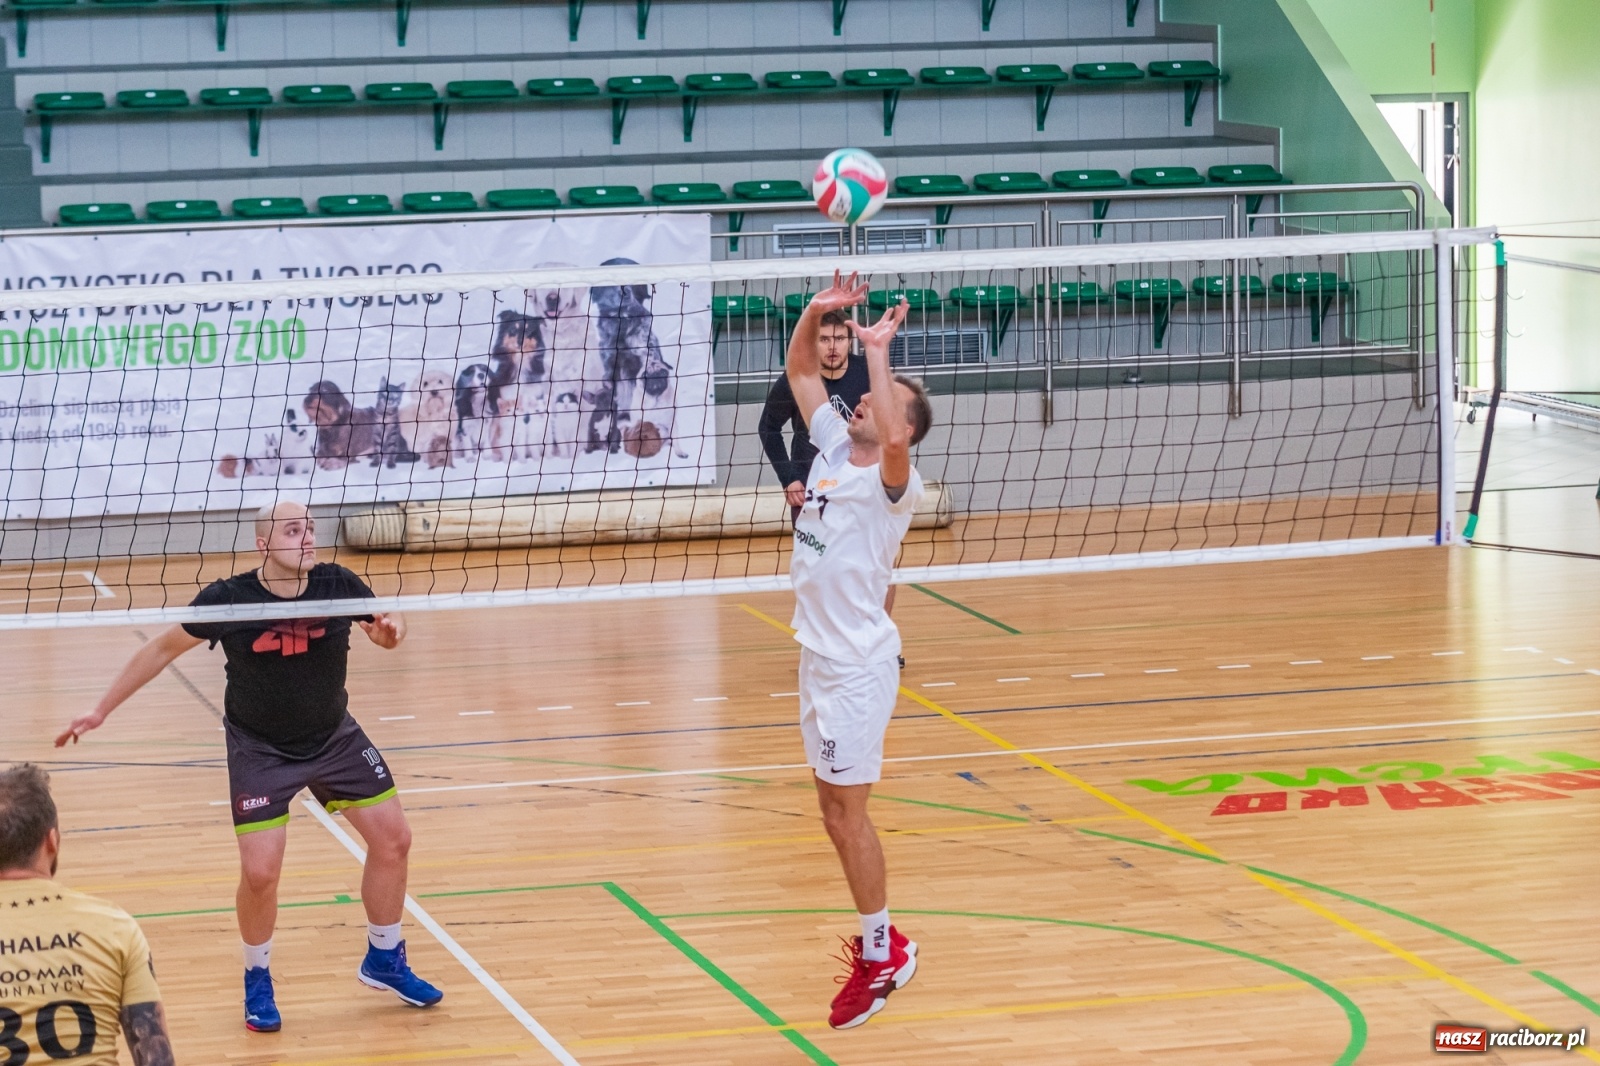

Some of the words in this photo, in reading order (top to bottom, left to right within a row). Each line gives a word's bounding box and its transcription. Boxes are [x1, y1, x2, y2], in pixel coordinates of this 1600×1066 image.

[0, 321, 218, 371] DOMOWEGO
[233, 317, 306, 362] ZOO
[361, 747, 381, 766] 10
[873, 923, 886, 948] FILA
